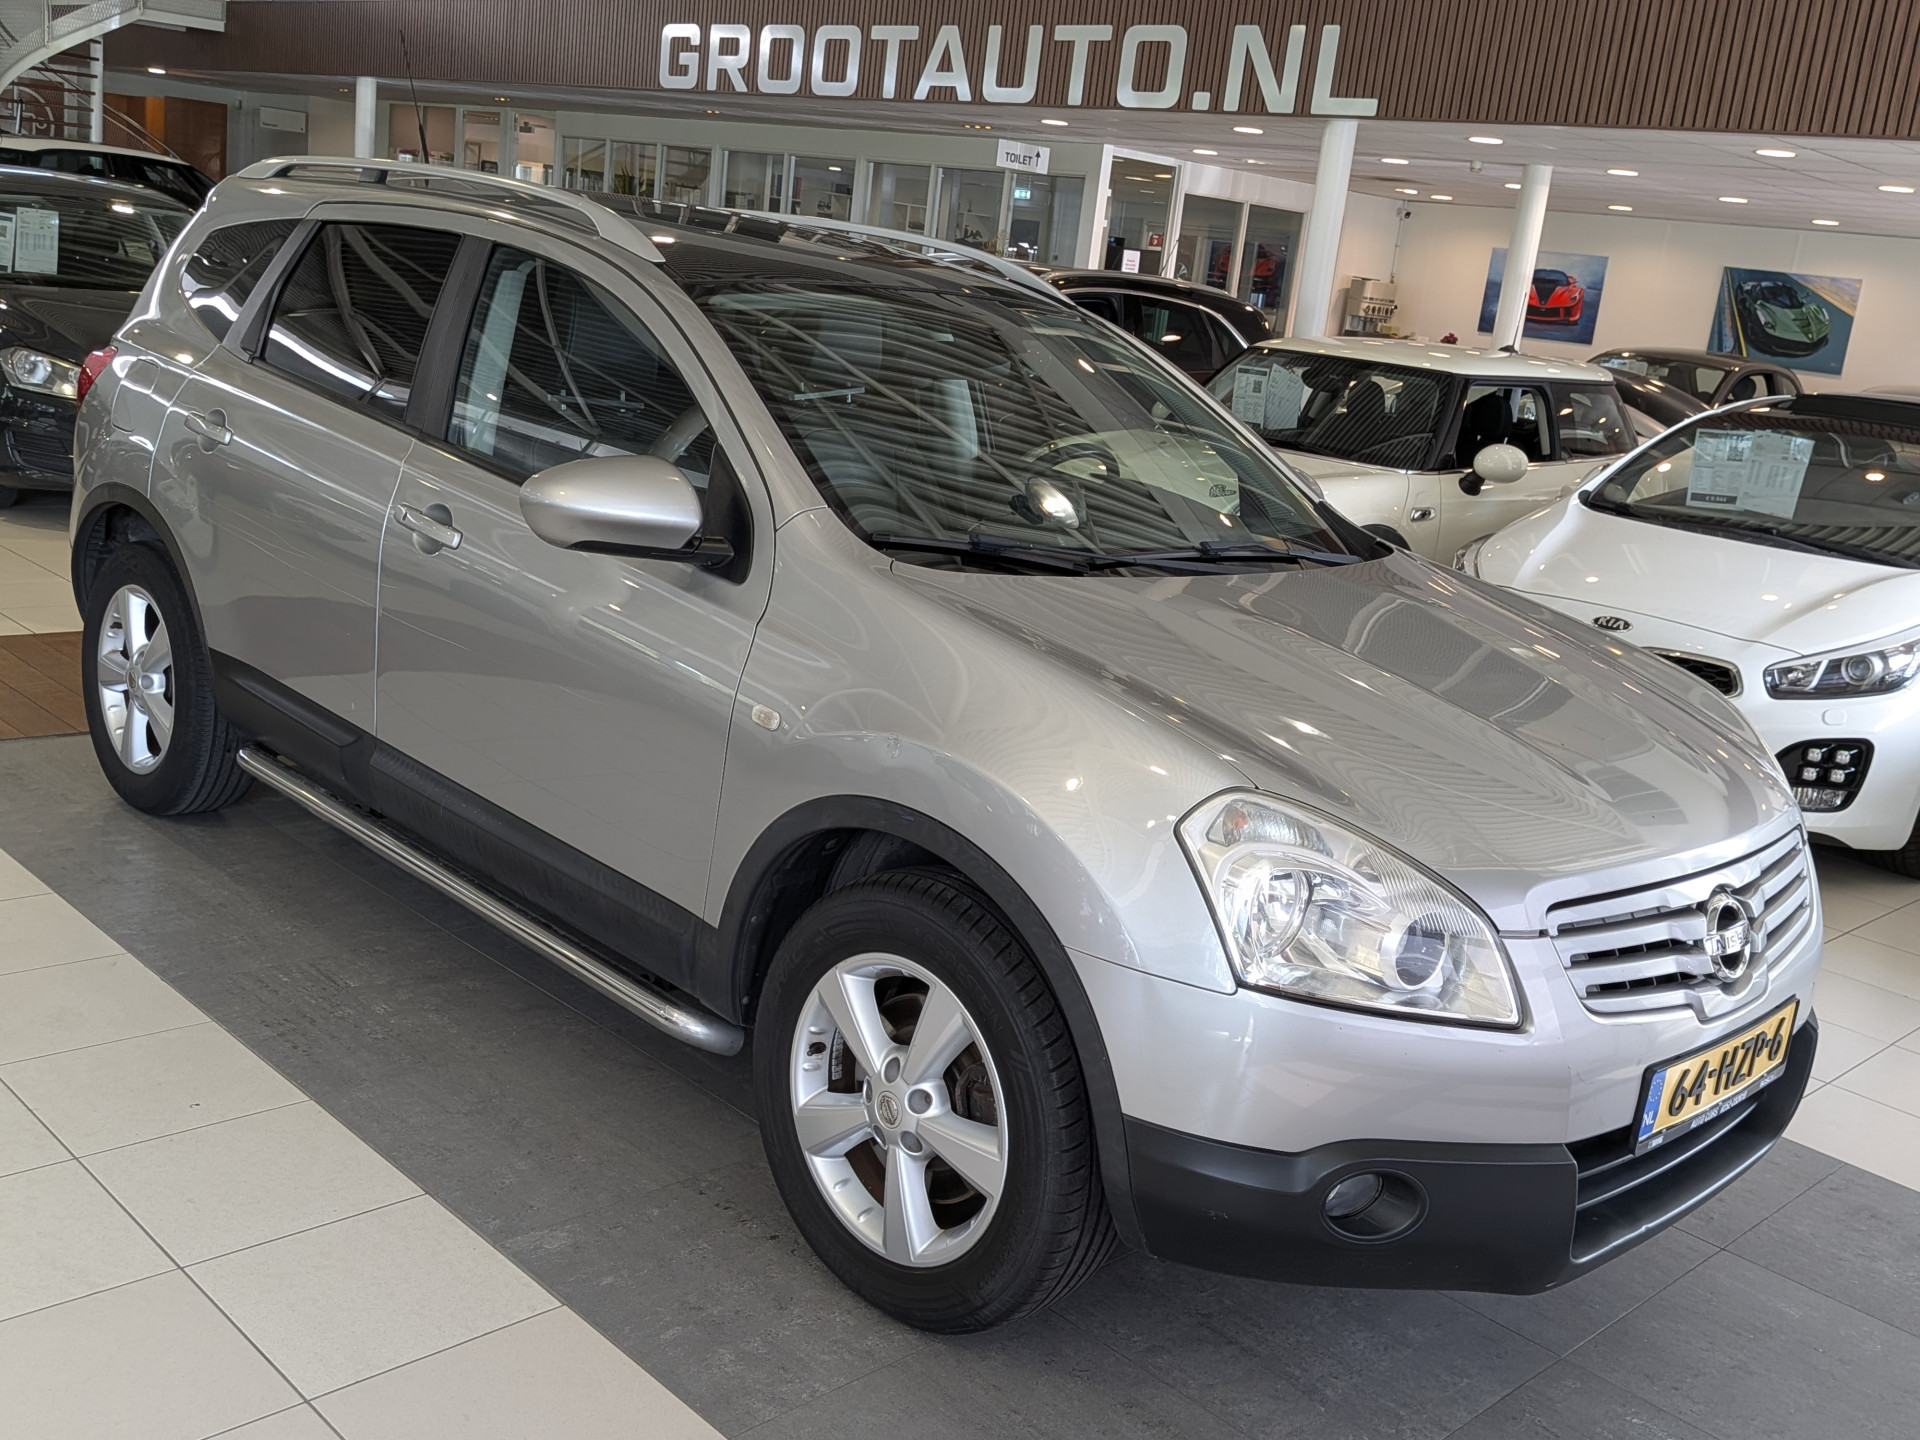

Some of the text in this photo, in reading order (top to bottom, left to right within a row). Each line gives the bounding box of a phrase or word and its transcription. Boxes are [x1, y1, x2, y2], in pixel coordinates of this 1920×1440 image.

[658, 22, 1379, 117] GROOTAUTO.NL
[1005, 151, 1033, 167] TOILET
[1597, 616, 1626, 631] KIA
[1668, 1016, 1787, 1117] 64-HZP-6
[1641, 1111, 1655, 1128] NL
